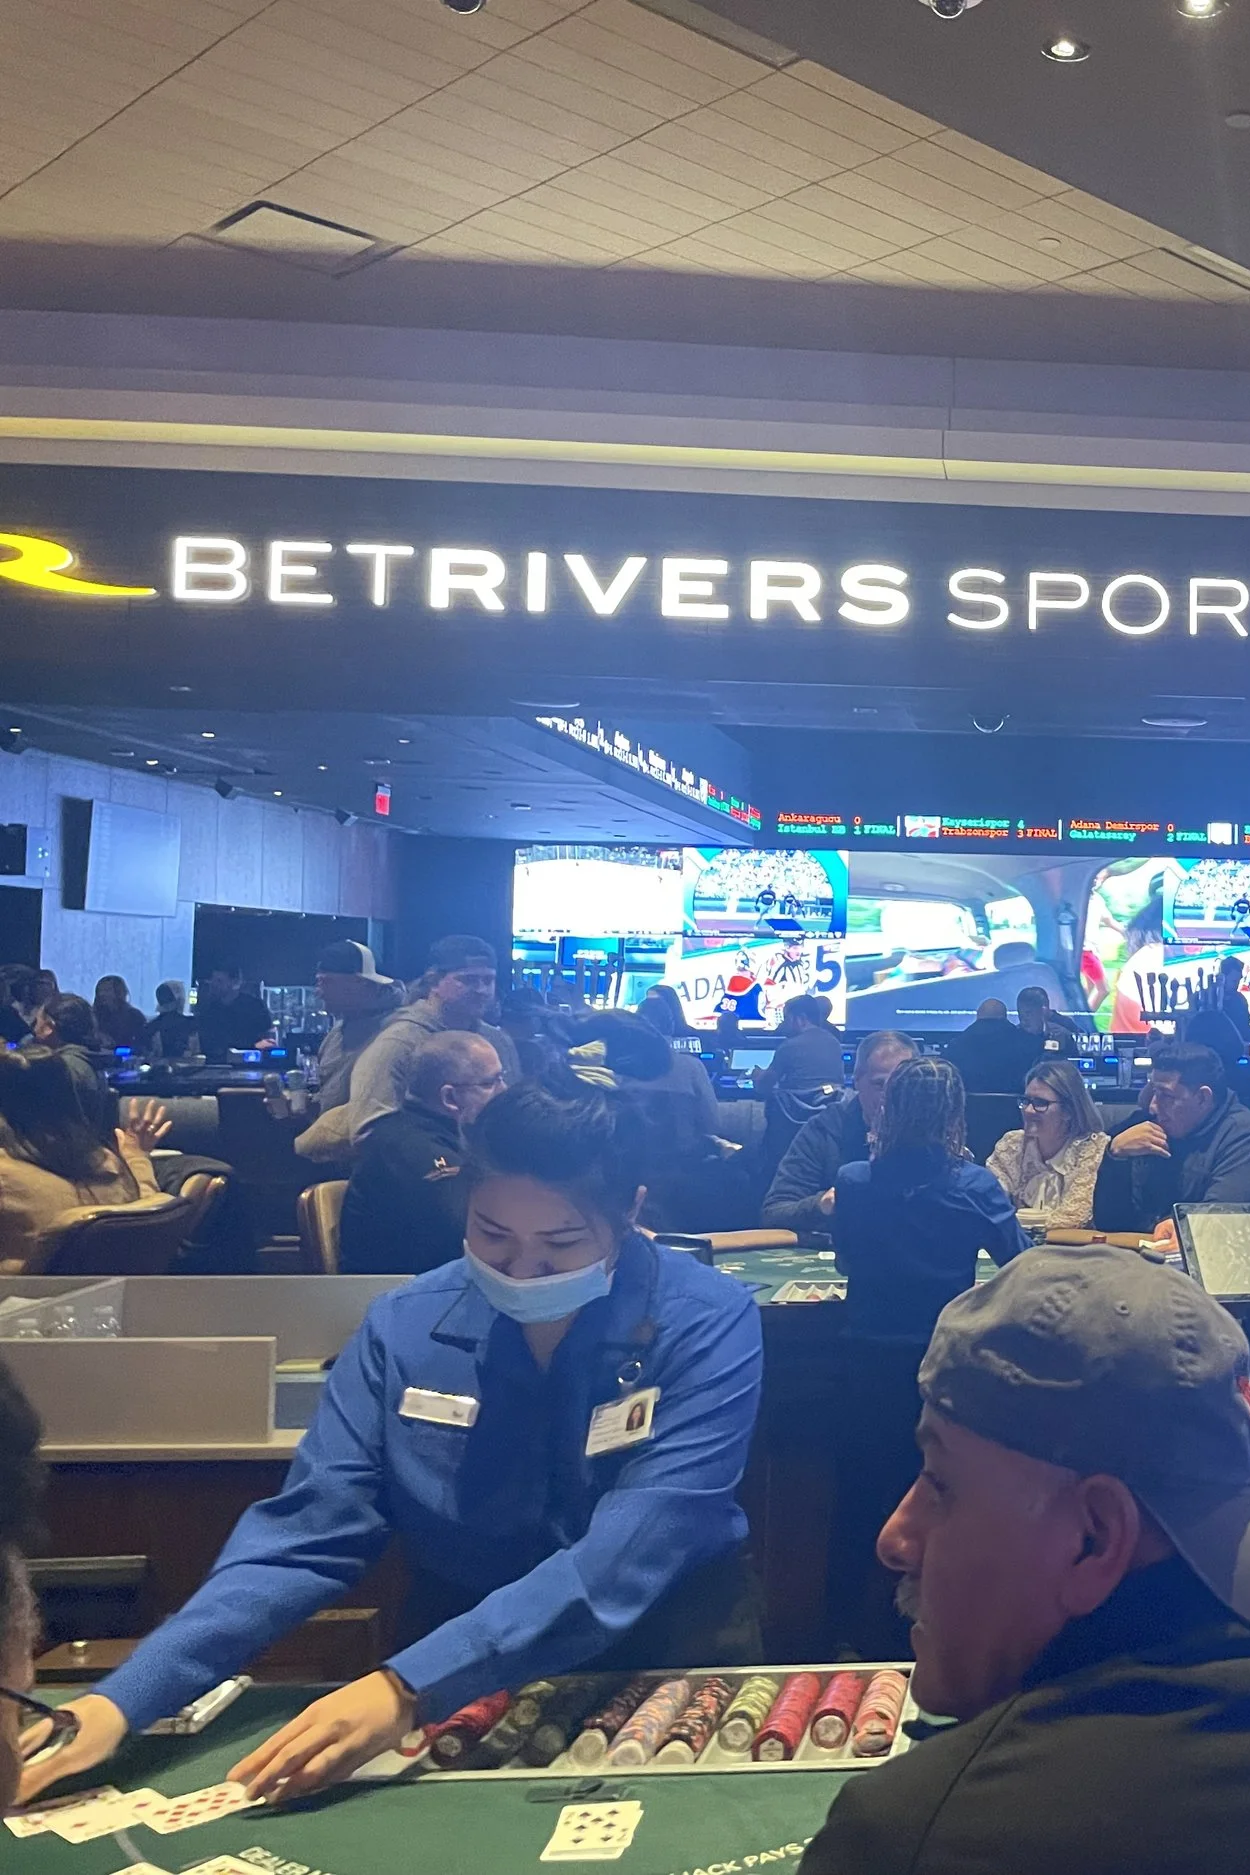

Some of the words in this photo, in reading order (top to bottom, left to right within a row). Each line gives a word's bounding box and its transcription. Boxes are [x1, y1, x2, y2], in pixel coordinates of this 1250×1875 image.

[172, 536, 910, 626] BETRIVERS
[778, 813, 841, 826] Ankaragucu
[942, 817, 1010, 829] Kayserispor
[1070, 820, 1101, 830] Adana
[777, 824, 826, 834] Istanbul
[854, 825, 861, 835] 1
[864, 825, 896, 835] FINAL
[942, 827, 1009, 838] Trabzonspor
[1017, 829, 1024, 838] 3
[1026, 829, 1058, 838] FINAL
[743, 1843, 805, 1868] PAYS
